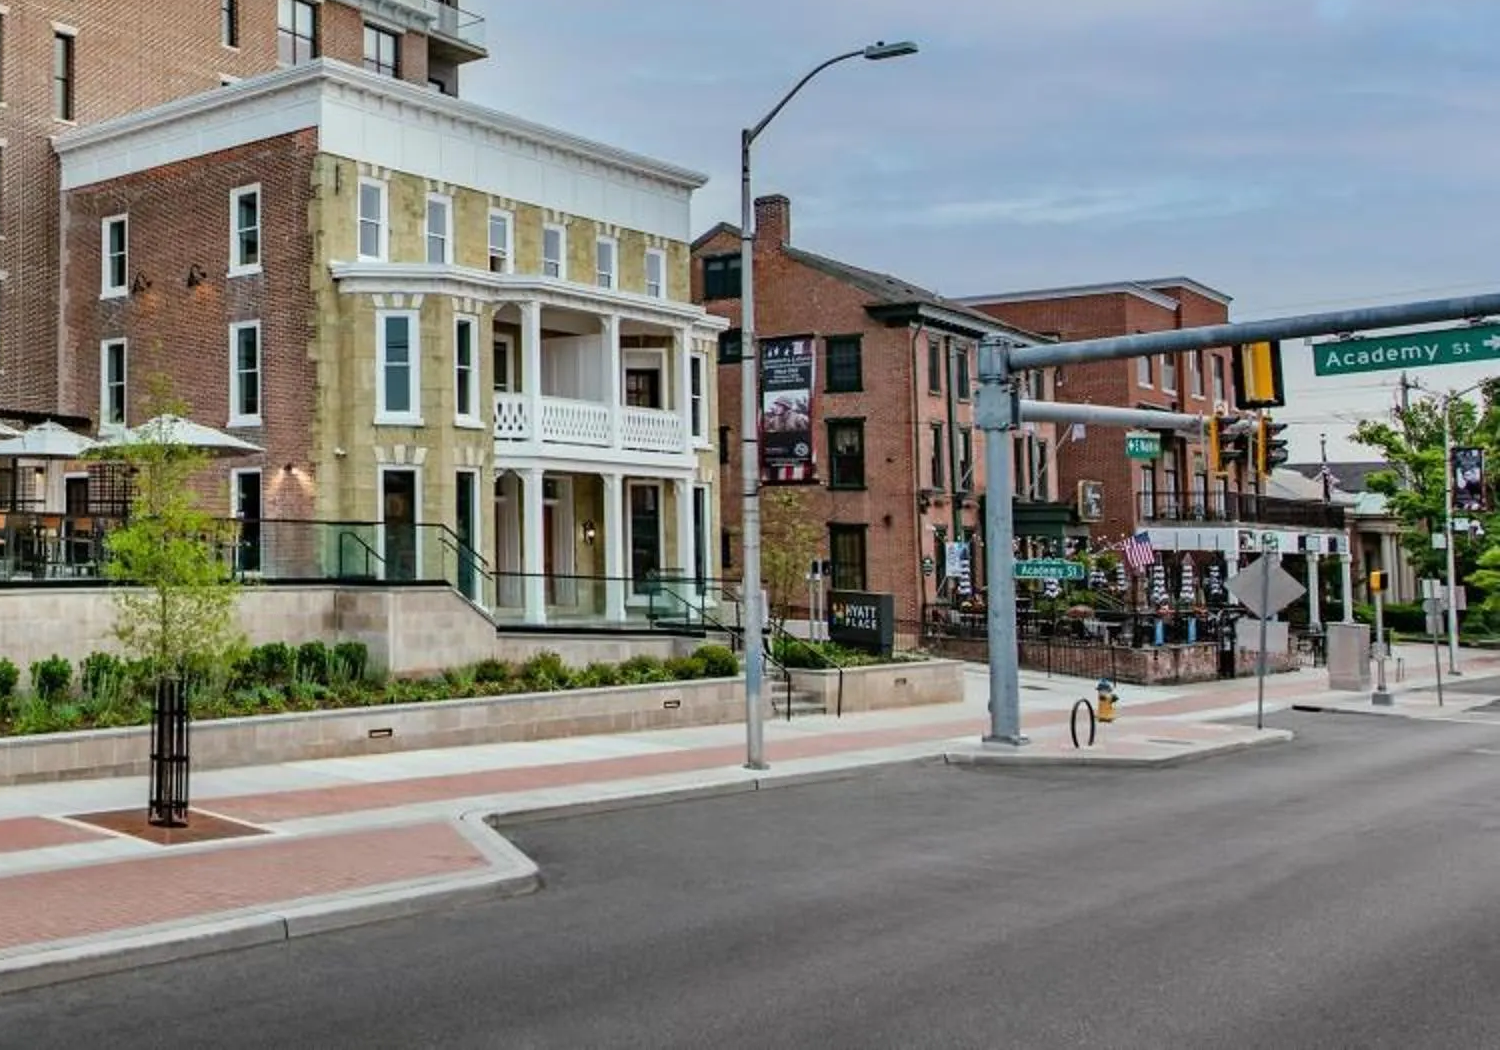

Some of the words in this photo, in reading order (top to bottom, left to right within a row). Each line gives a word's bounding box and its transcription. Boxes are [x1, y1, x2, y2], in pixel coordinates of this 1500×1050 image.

[1325, 343, 1439, 367] Academy
[1452, 342, 1471, 355] St
[1022, 564, 1064, 577] Academy
[846, 604, 876, 618] HYATT
[846, 618, 876, 630] PLACE
